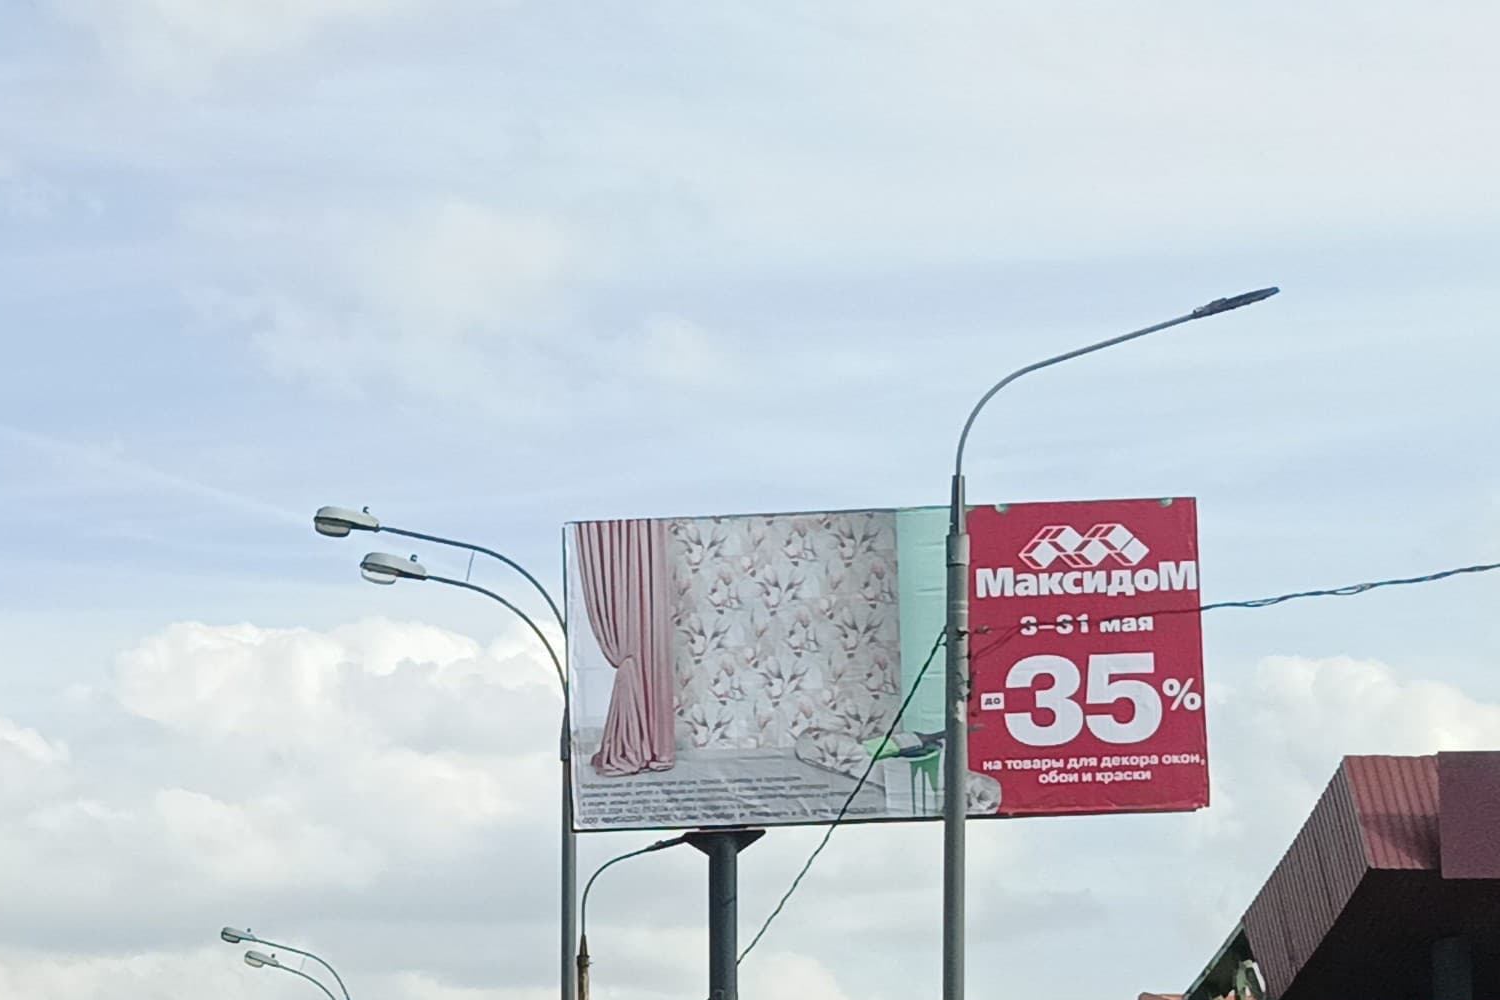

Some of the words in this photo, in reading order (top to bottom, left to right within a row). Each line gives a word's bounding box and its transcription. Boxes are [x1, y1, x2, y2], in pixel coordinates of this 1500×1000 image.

[1099, 616, 1153, 633] мая
[983, 759, 1003, 770] на
[1005, 757, 1064, 774] товары
[1066, 757, 1097, 770] для
[1100, 754, 1158, 770] декора
[1038, 769, 1078, 784] обои
[1082, 771, 1092, 782] и
[1095, 768, 1151, 784] краски
